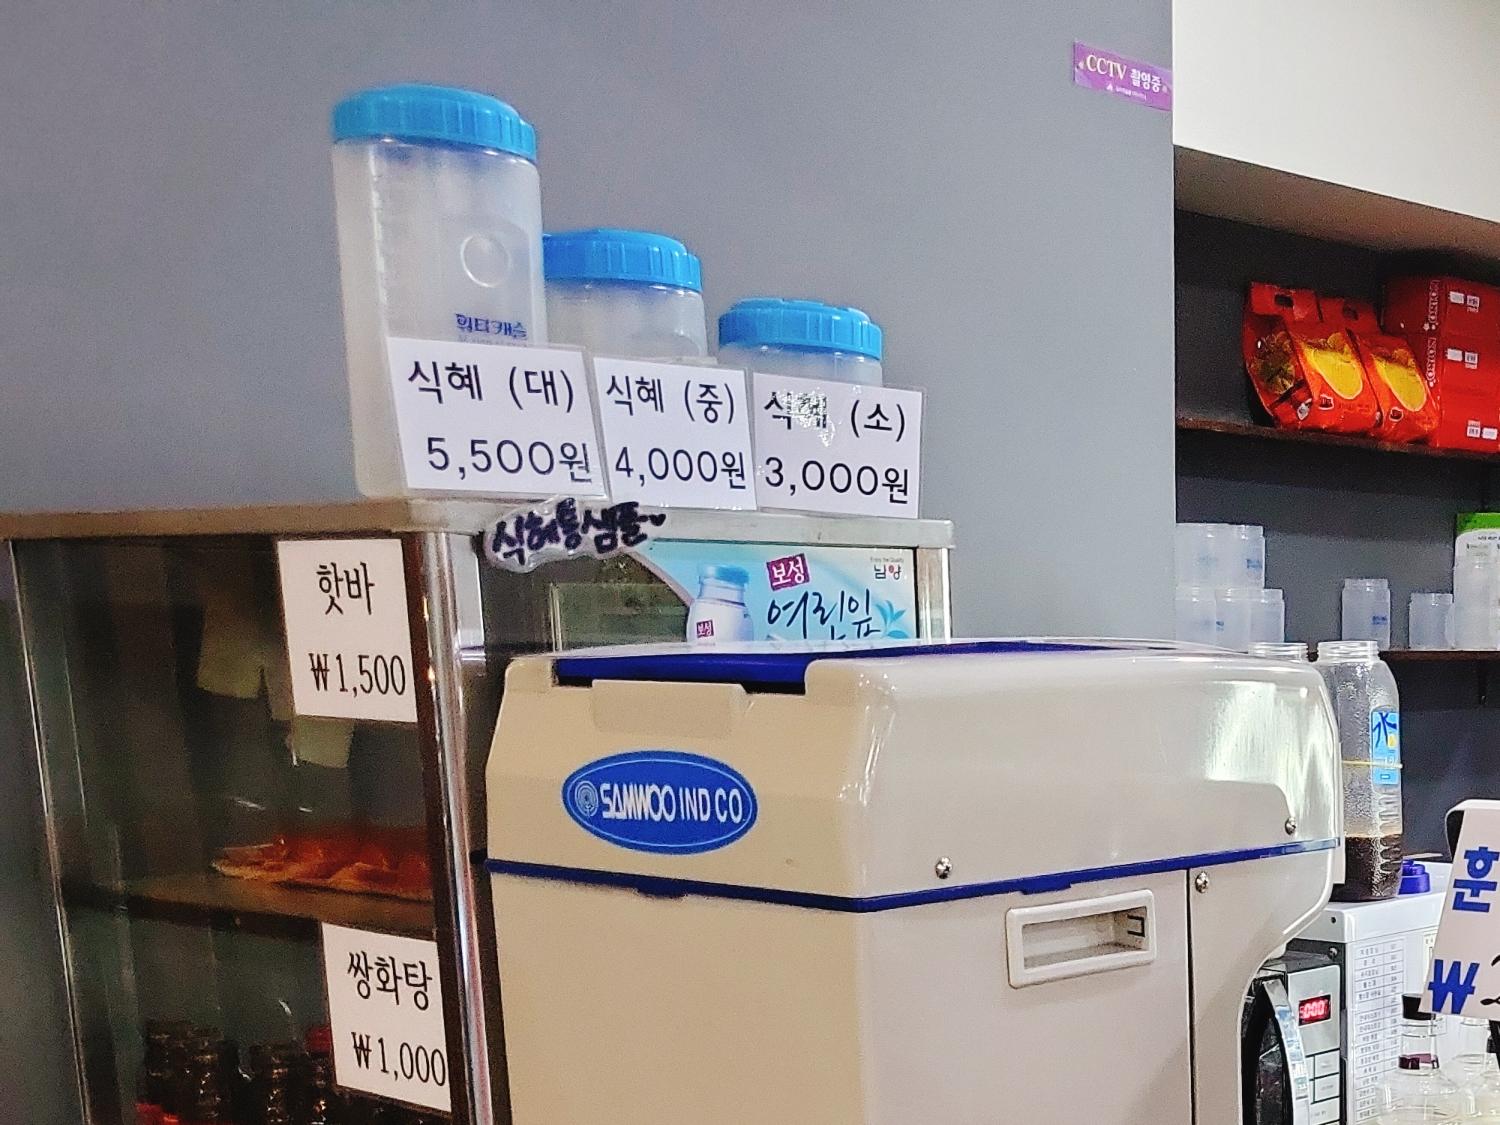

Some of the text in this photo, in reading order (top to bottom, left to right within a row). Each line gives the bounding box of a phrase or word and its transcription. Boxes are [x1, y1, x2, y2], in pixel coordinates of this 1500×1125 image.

[1086, 54, 1162, 92] CCTV 촬영중
[407, 361, 574, 413] 식혜 (대)
[606, 375, 735, 424] 식혜 (중)
[850, 399, 906, 442] (소)
[427, 436, 592, 484] 5,500원
[615, 446, 747, 490] 4,000원
[765, 456, 909, 504] 3,000원
[316, 561, 376, 616] 핫바
[771, 556, 806, 587] 보성
[600, 782, 676, 823] SAMWOO
[679, 786, 711, 822] IND
[347, 950, 433, 1011] 쌍화탕
